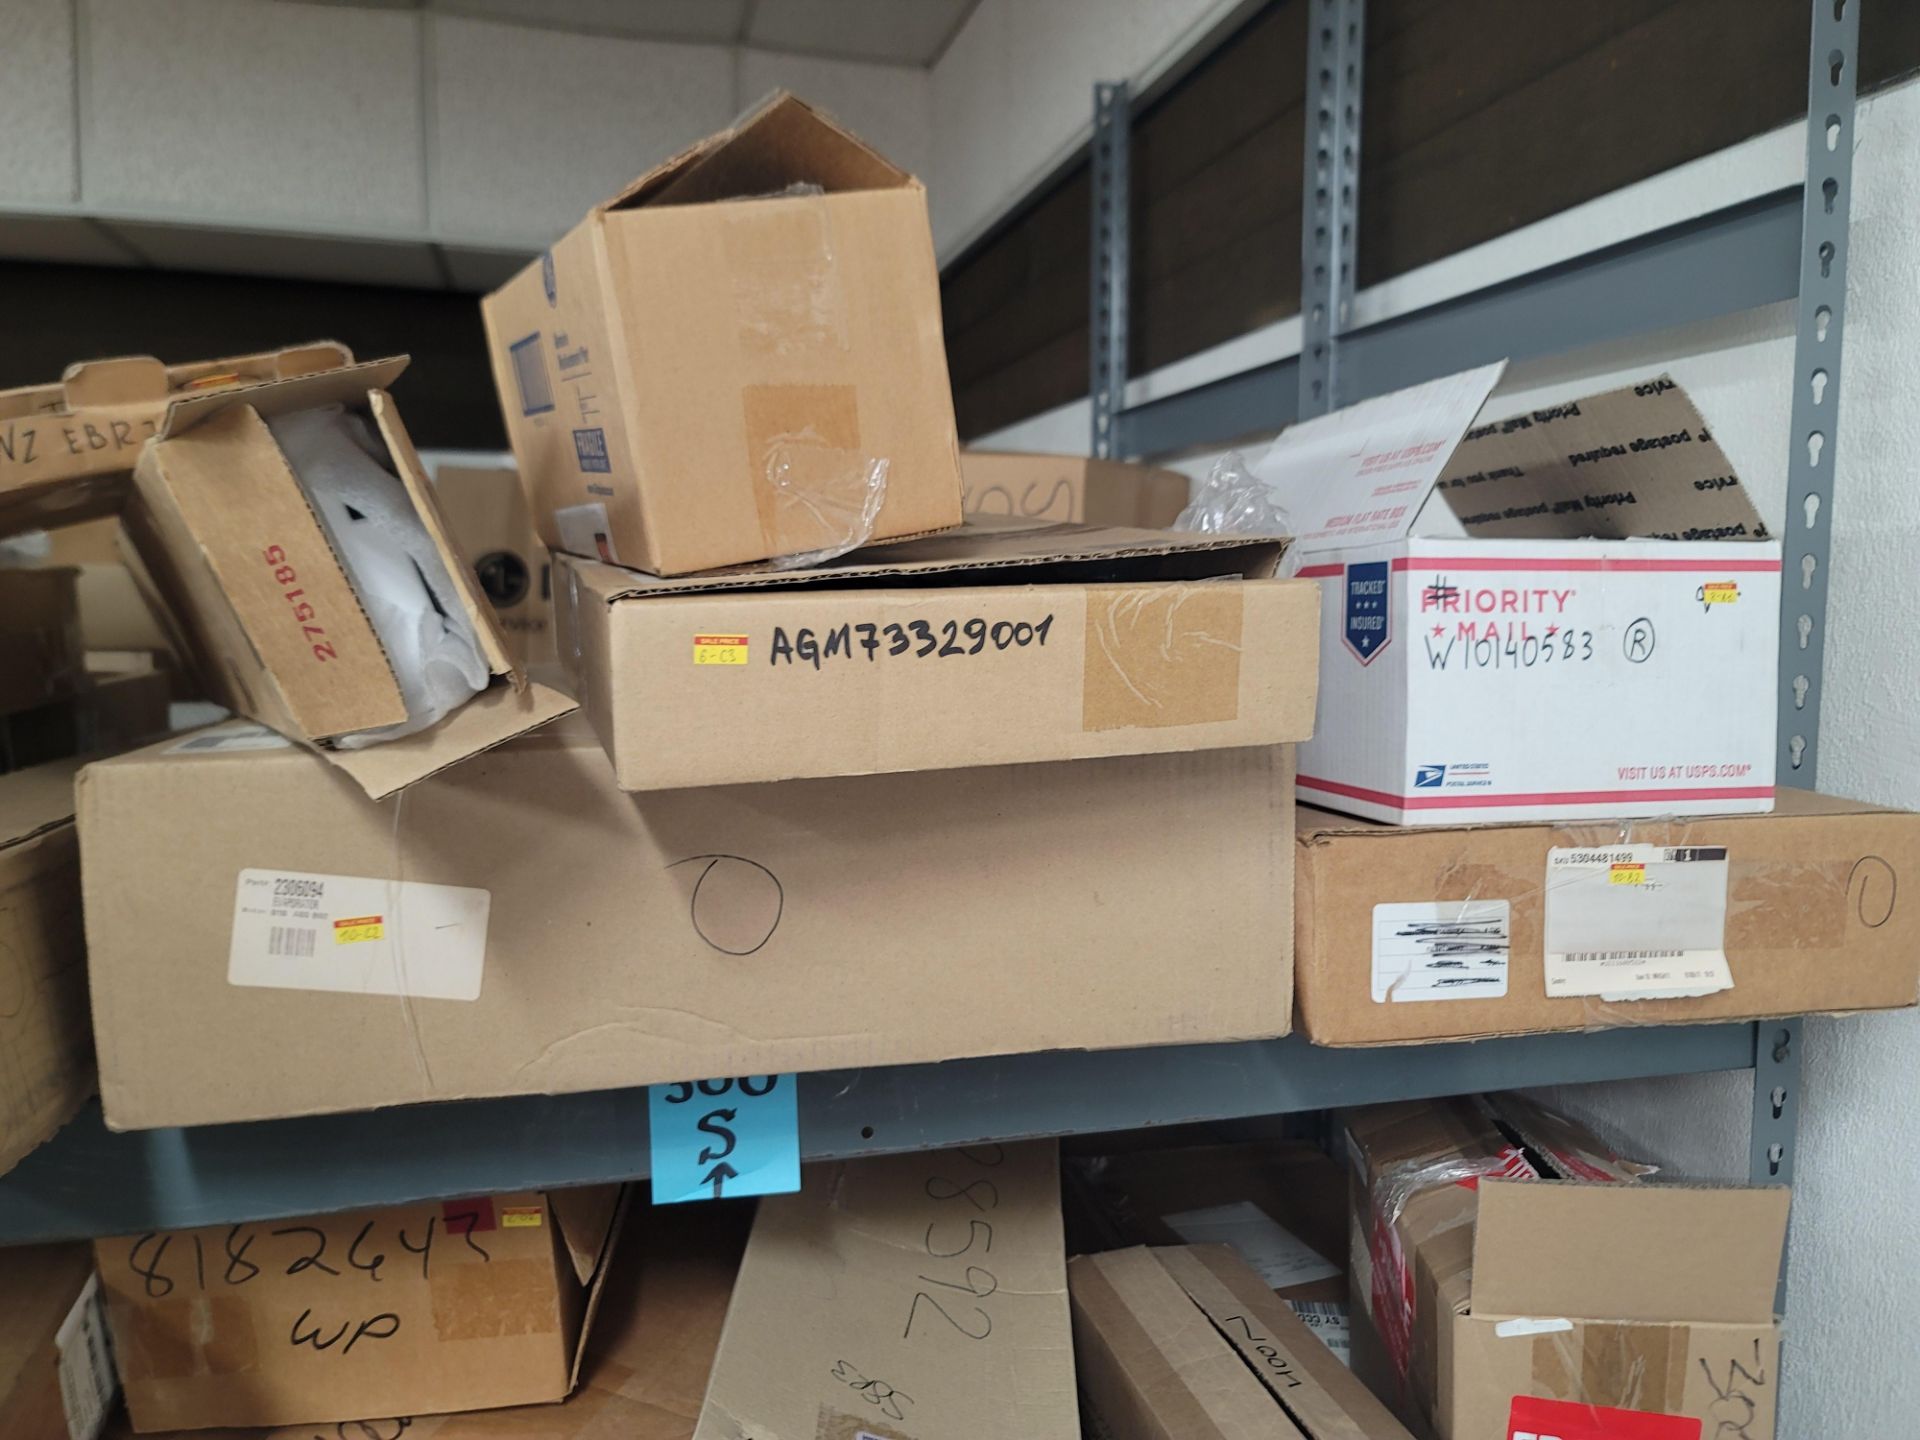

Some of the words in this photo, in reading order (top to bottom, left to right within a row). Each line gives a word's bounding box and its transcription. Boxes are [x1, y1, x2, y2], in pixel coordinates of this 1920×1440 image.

[1629, 429, 1692, 454] postage
[1568, 444, 1627, 467] required
[1350, 580, 1386, 595] TRACKED
[263, 545, 338, 662] 275185
[1350, 614, 1384, 630] INSURED
[1457, 621, 1530, 641] MAIL
[770, 614, 1054, 671] AGM73329001
[1424, 629, 1595, 670] W10140583
[1617, 766, 1648, 780] VISIT
[1650, 766, 1667, 780] US
[1667, 765, 1683, 779] AT
[697, 1107, 738, 1166] S
[290, 1307, 400, 1354] WP
